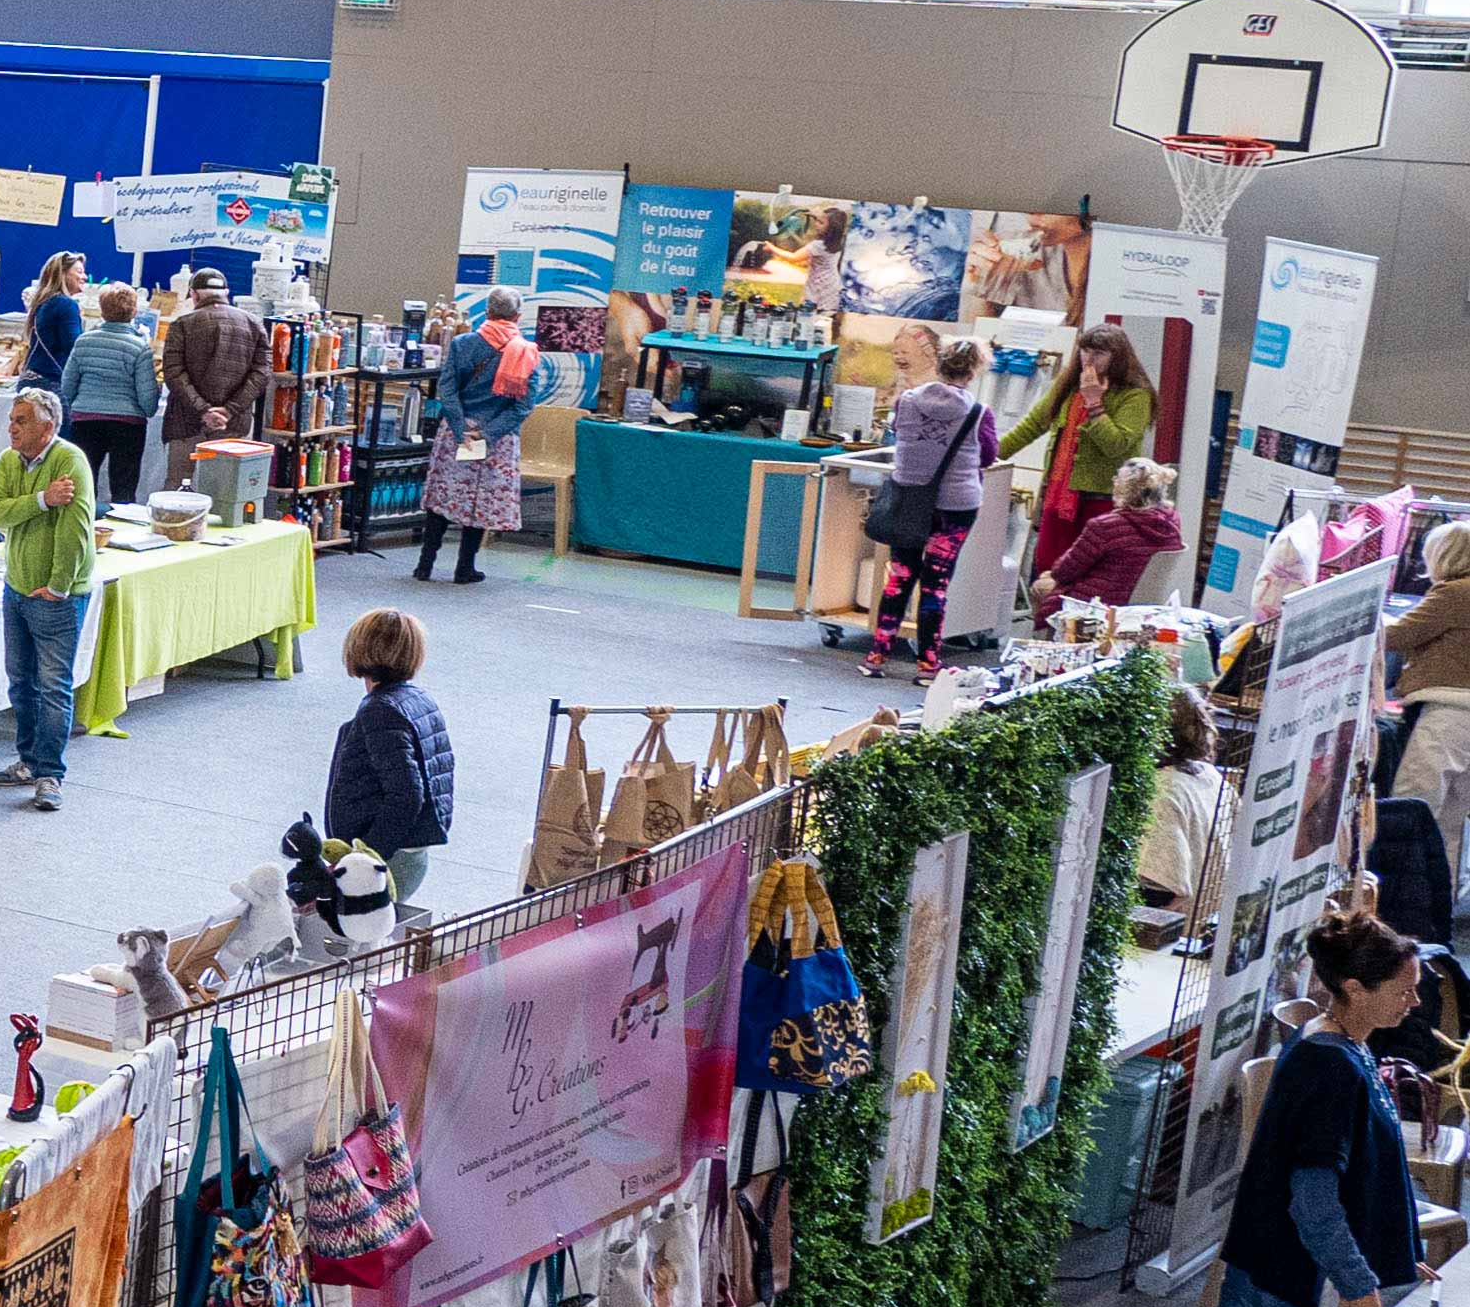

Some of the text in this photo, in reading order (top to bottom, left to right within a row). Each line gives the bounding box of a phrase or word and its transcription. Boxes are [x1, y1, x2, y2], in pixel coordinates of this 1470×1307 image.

[117, 183, 170, 202] écologiques
[172, 185, 193, 198] pour
[521, 188, 607, 203] eauriginelle
[117, 204, 193, 221] et particuliers
[640, 203, 713, 220] Retrouver
[643, 221, 705, 245] le plaisir
[643, 241, 698, 262] du goût
[1123, 249, 1189, 268] HYDRALOOP
[640, 259, 695, 276] de l'eau
